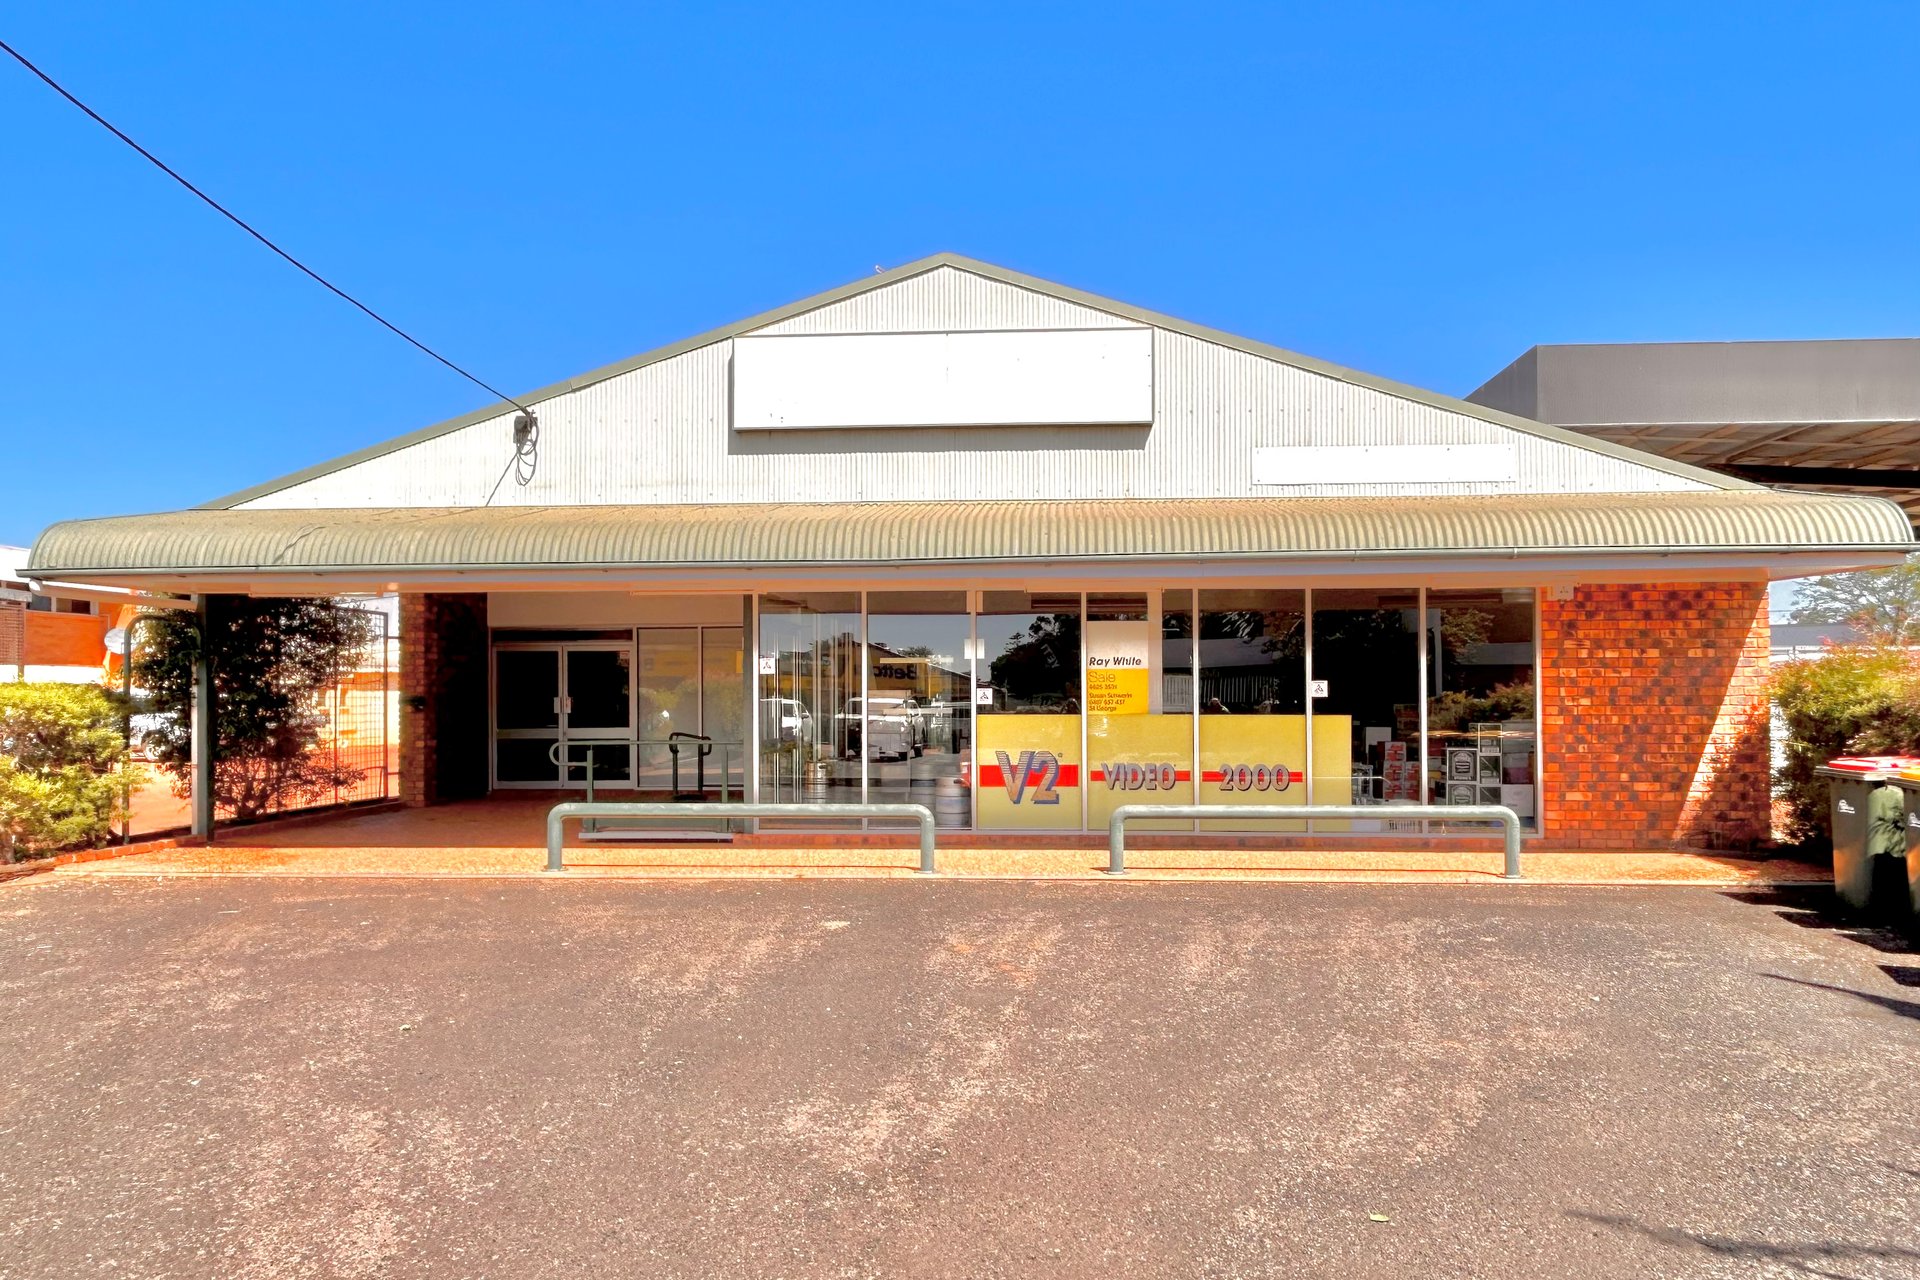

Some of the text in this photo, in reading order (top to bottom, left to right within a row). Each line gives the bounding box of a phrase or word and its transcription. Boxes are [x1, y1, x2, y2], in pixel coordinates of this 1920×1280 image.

[1089, 656, 1141, 667] Ray White
[1089, 671, 1116, 683] Sale
[995, 750, 1060, 805] V2
[1101, 762, 1290, 792] VIDEO 2000
